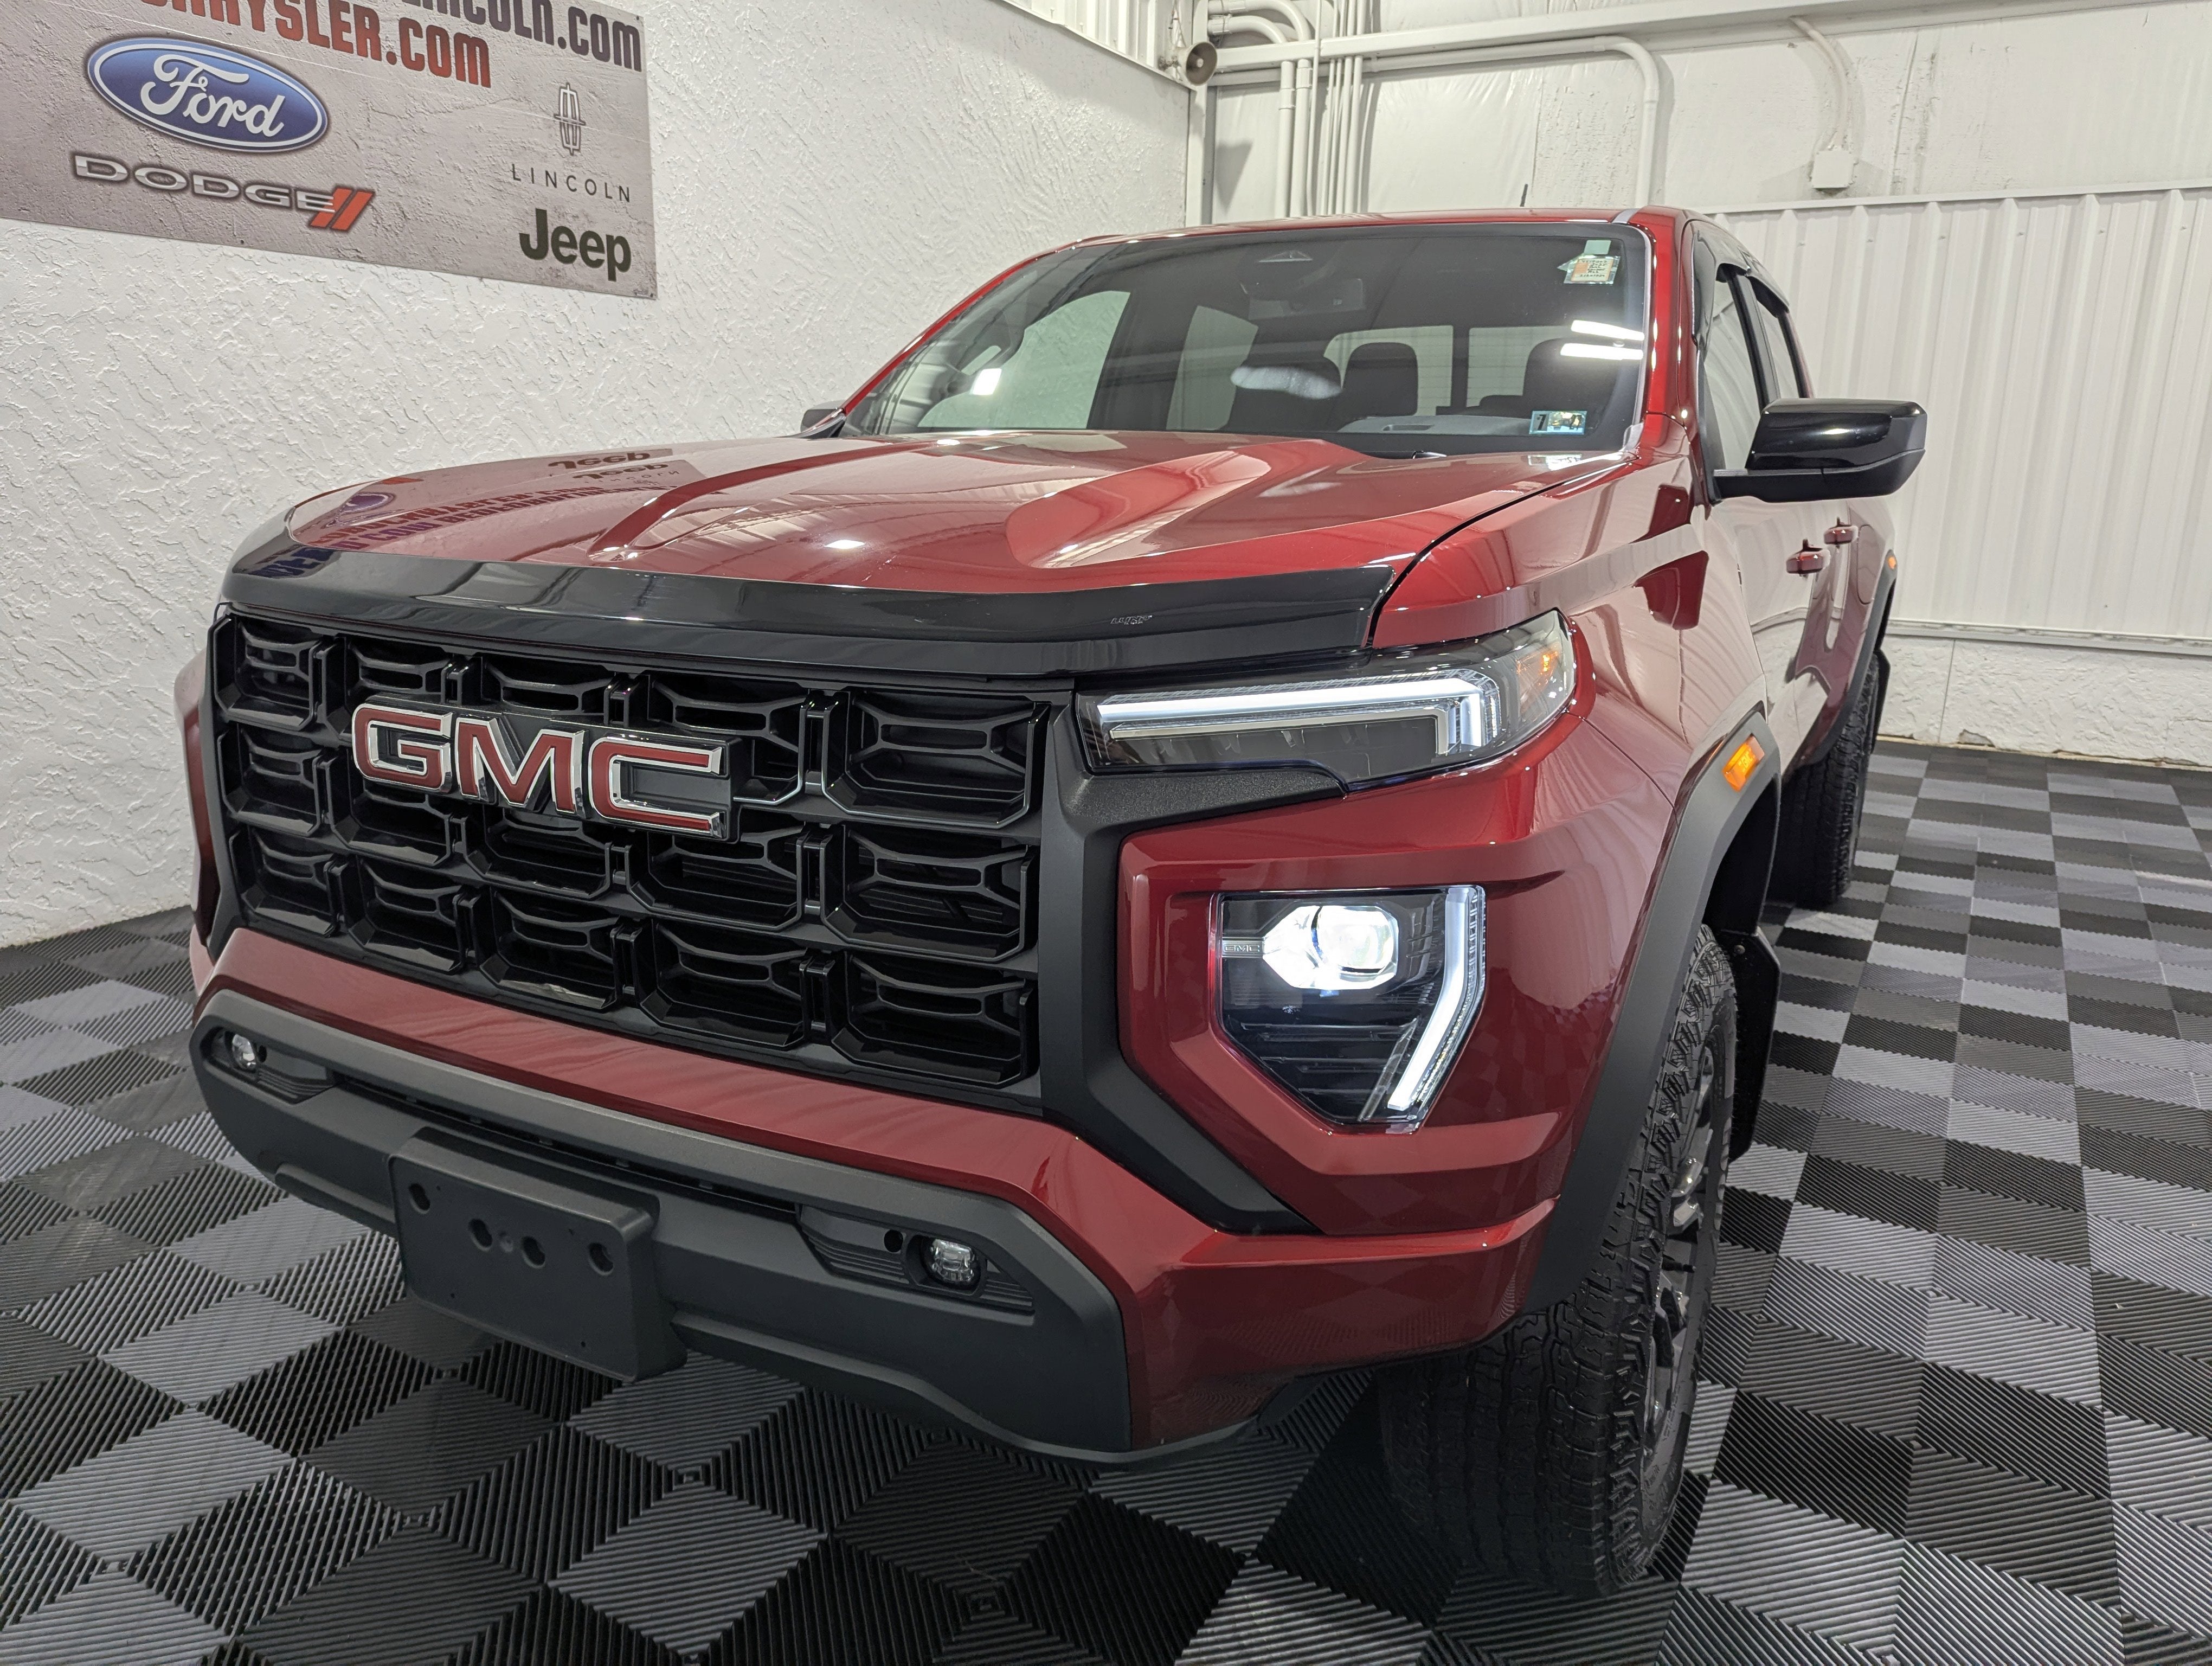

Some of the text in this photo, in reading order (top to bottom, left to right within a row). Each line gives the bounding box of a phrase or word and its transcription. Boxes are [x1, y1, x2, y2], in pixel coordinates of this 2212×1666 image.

[140, 54, 285, 137] Ford
[74, 155, 336, 213] DODGE
[512, 163, 630, 203] LINCOLN
[518, 208, 632, 282] Jeep
[351, 702, 725, 840] GMC
